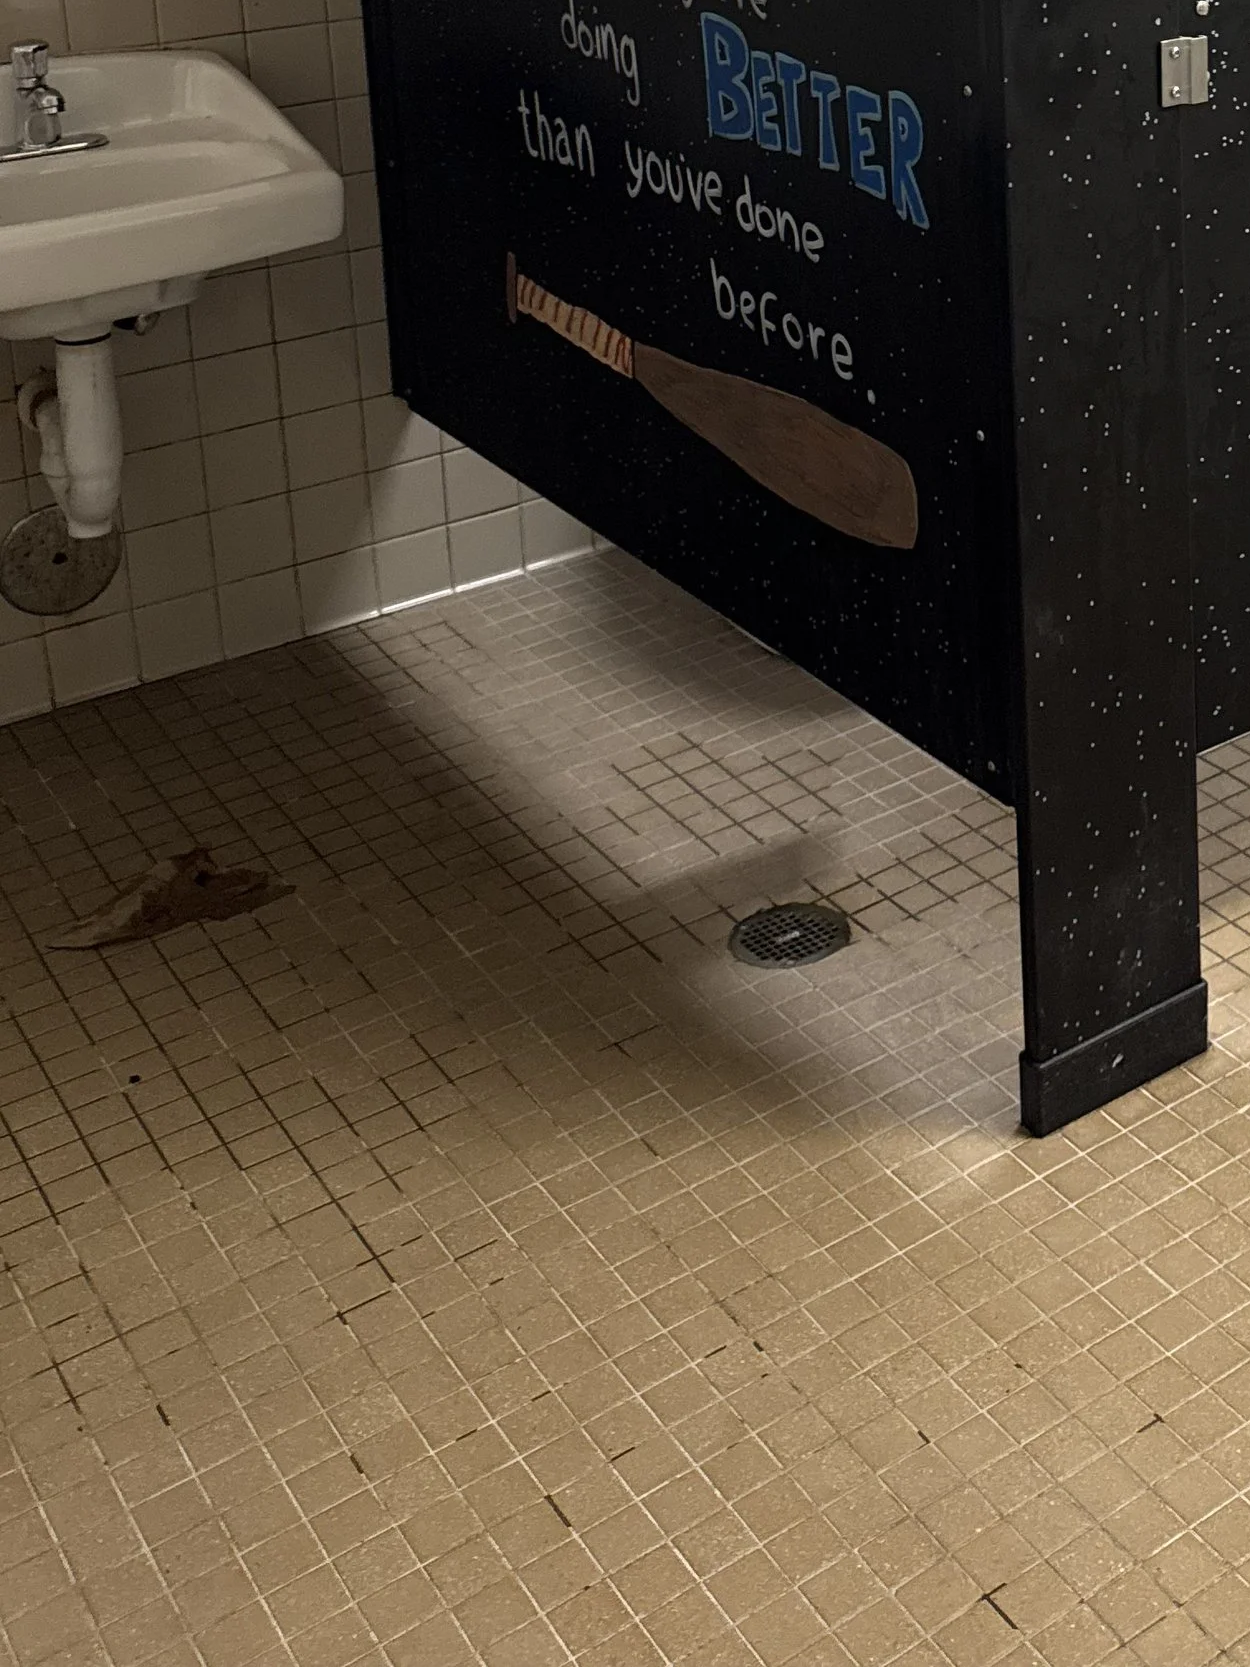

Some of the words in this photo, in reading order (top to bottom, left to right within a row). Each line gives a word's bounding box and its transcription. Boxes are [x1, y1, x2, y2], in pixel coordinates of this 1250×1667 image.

[517, 88, 595, 178] than
[624, 140, 722, 216] you've
[735, 174, 825, 263] done
[700, 11, 930, 230] BETTER
[710, 258, 876, 404] before.
